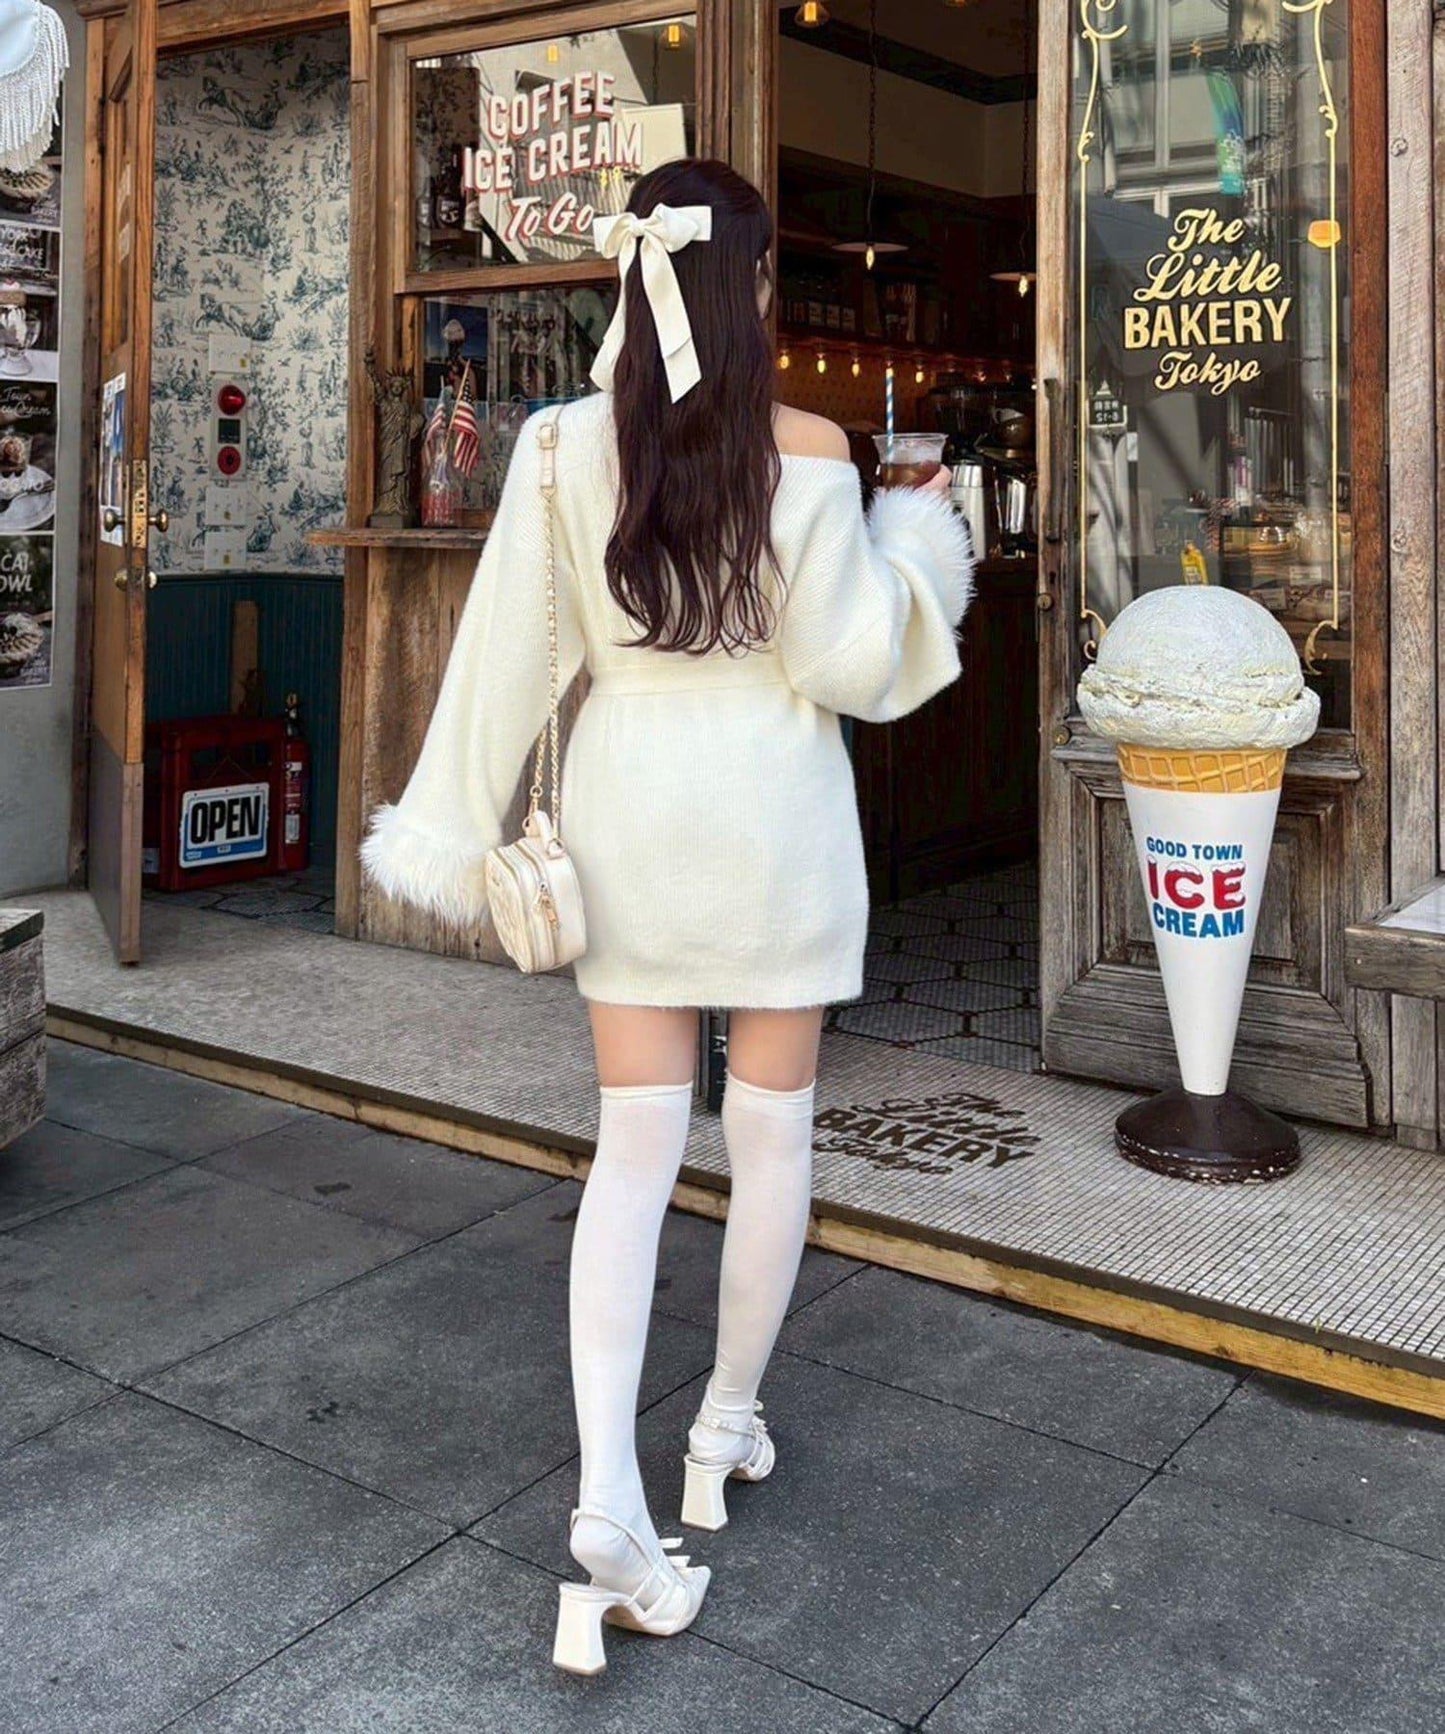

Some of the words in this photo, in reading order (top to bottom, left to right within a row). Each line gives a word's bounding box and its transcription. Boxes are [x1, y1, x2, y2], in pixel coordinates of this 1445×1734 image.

[486, 70, 615, 141] COFFEE
[461, 146, 516, 194] ICE
[526, 118, 644, 186] CREAM
[503, 195, 542, 243] To
[547, 191, 595, 237] Go
[1167, 208, 1245, 252] The
[1132, 249, 1283, 302] Little
[1123, 297, 1292, 349] BAKERY
[1154, 350, 1261, 396] Tokyo
[190, 795, 262, 845] OPEN
[1146, 836, 1187, 857] GOOD
[1192, 844, 1243, 860] TOWN
[1146, 854, 1246, 910] ICE
[1153, 902, 1244, 938] CREAM
[812, 1107, 1036, 1169] BAKERY
